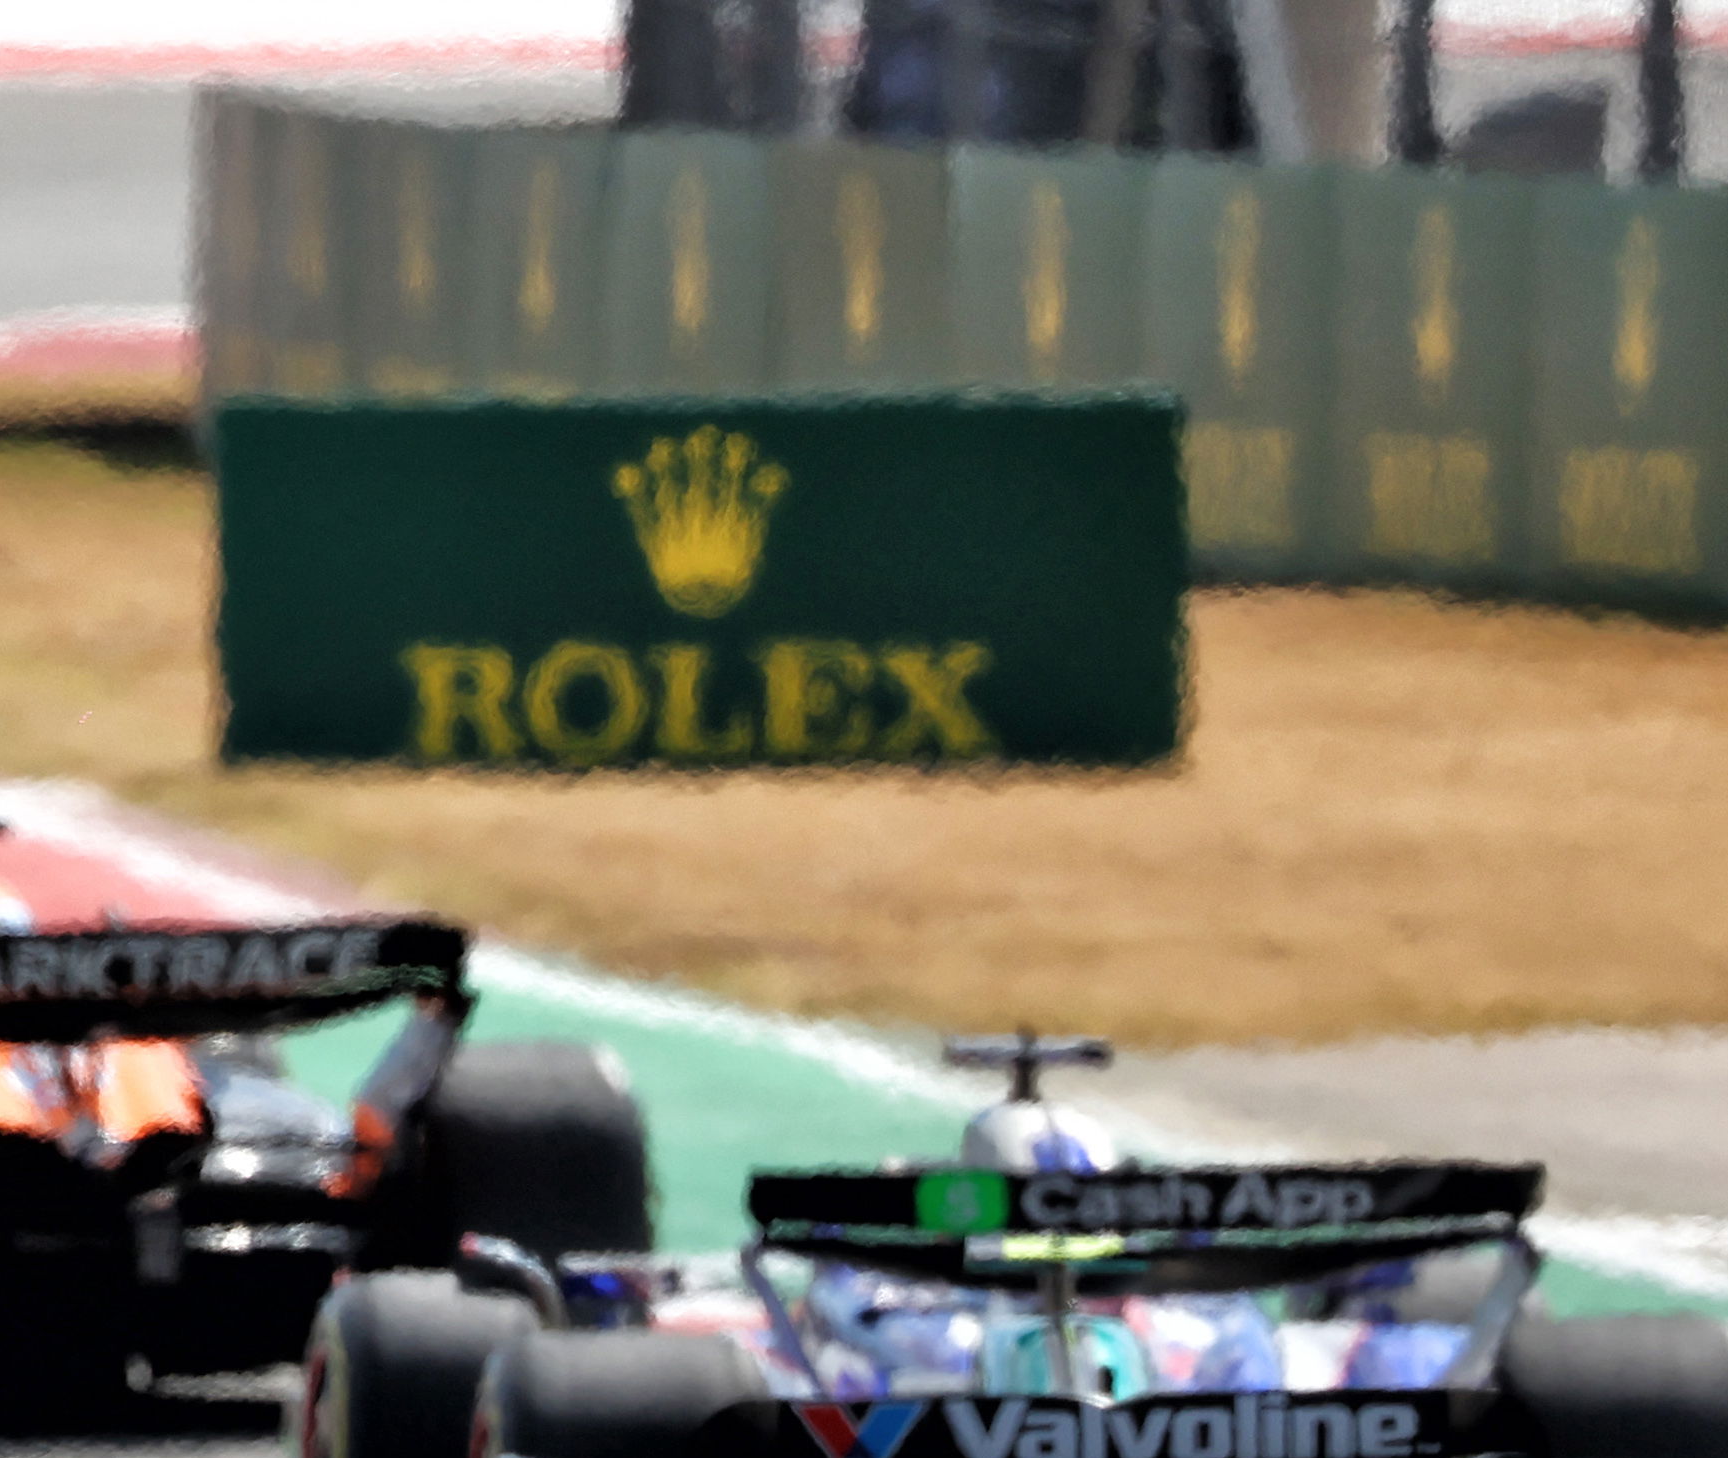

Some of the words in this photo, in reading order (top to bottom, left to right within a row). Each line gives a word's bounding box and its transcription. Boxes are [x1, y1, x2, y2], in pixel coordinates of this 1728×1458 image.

[401, 639, 993, 762] ROLEX
[1021, 1170, 1215, 1226] Cash
[1219, 1170, 1375, 1230] App
